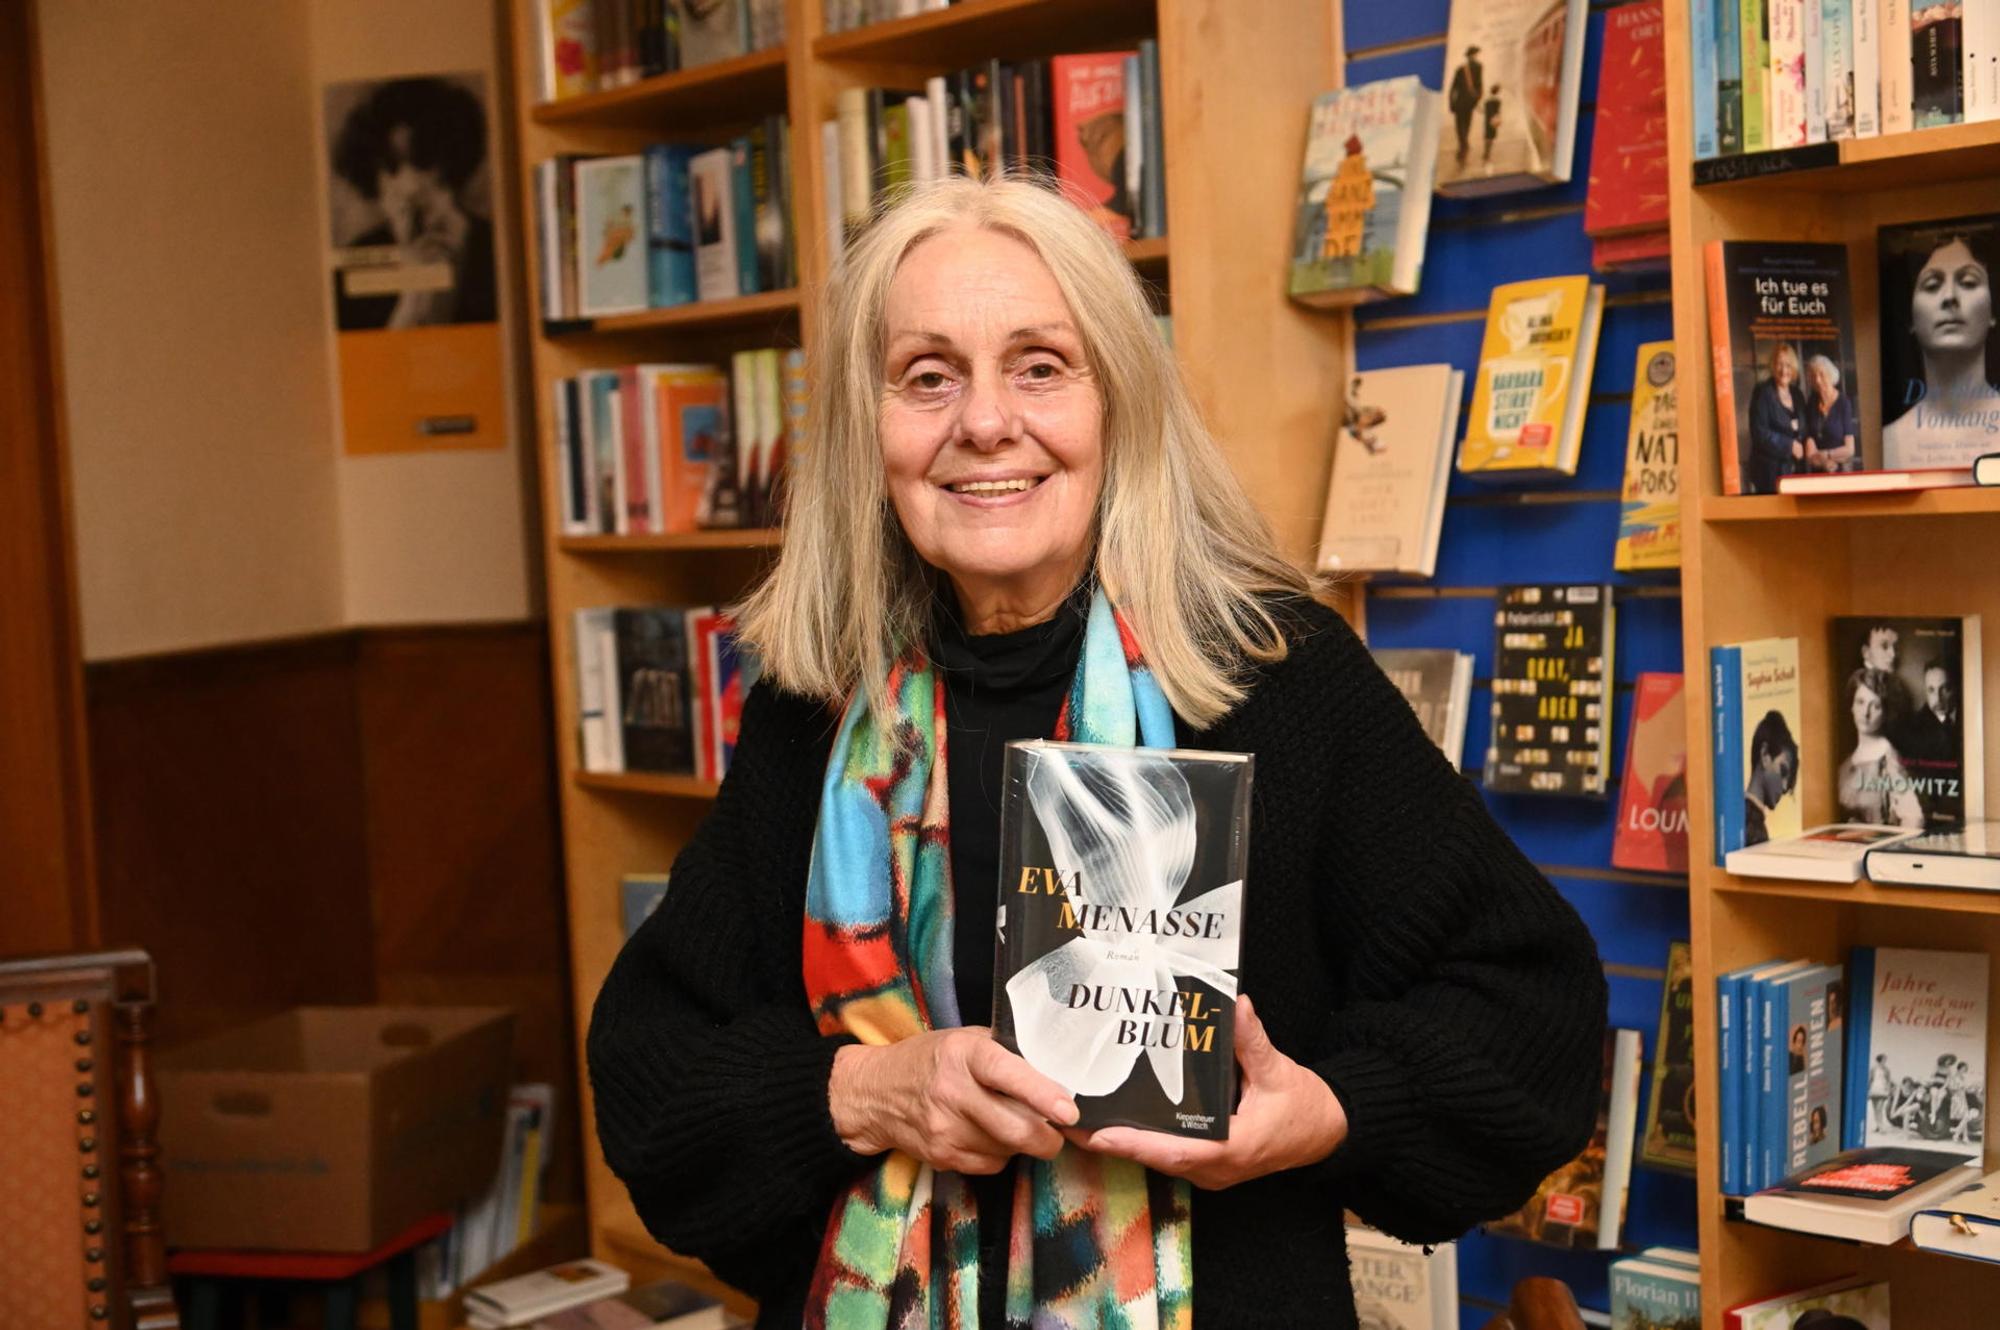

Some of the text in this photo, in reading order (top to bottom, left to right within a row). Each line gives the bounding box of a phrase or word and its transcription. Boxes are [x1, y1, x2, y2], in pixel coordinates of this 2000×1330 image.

[1755, 277, 1829, 296] Ich tue es
[1761, 296, 1826, 314] für Euch
[1018, 866, 1083, 897] EVA
[1056, 902, 1225, 940] MENASSE
[1106, 949, 1140, 961] Roman
[1880, 972, 1937, 993] Jahre
[1067, 983, 1221, 1020] DUNKEL-
[1887, 1006, 1963, 1028] Kleider
[1117, 1019, 1216, 1053] BLUM
[1809, 998, 1825, 1076] INNEN
[1176, 1112, 1215, 1123] Kiepenheuer
[1792, 1074, 1808, 1168] REBELL
[1360, 1257, 1406, 1280] TER
[1354, 1278, 1418, 1303] ANGE
[1615, 1275, 1679, 1306] Florian
